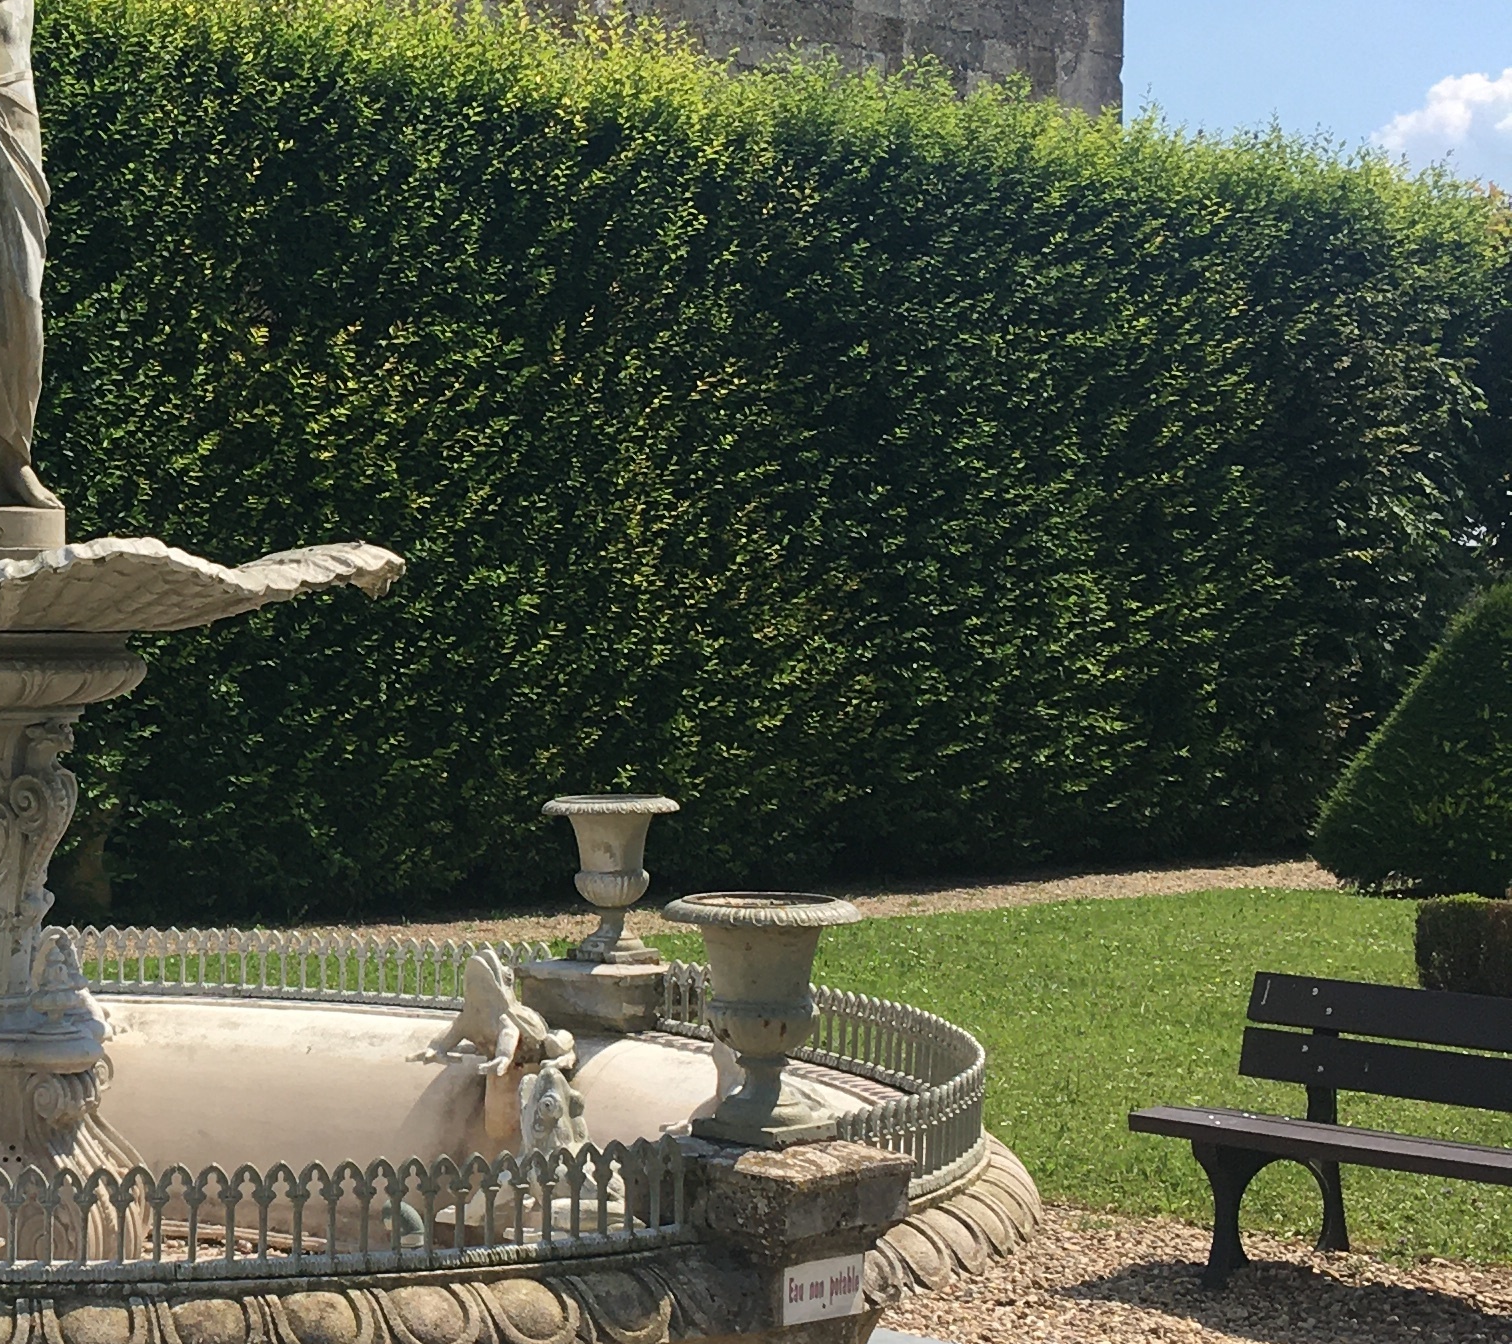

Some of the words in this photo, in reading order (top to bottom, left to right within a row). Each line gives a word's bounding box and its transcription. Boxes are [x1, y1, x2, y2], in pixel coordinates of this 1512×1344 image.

[788, 1277, 804, 1304] Eau
[809, 1280, 825, 1301] non
[829, 1264, 860, 1306] potable
